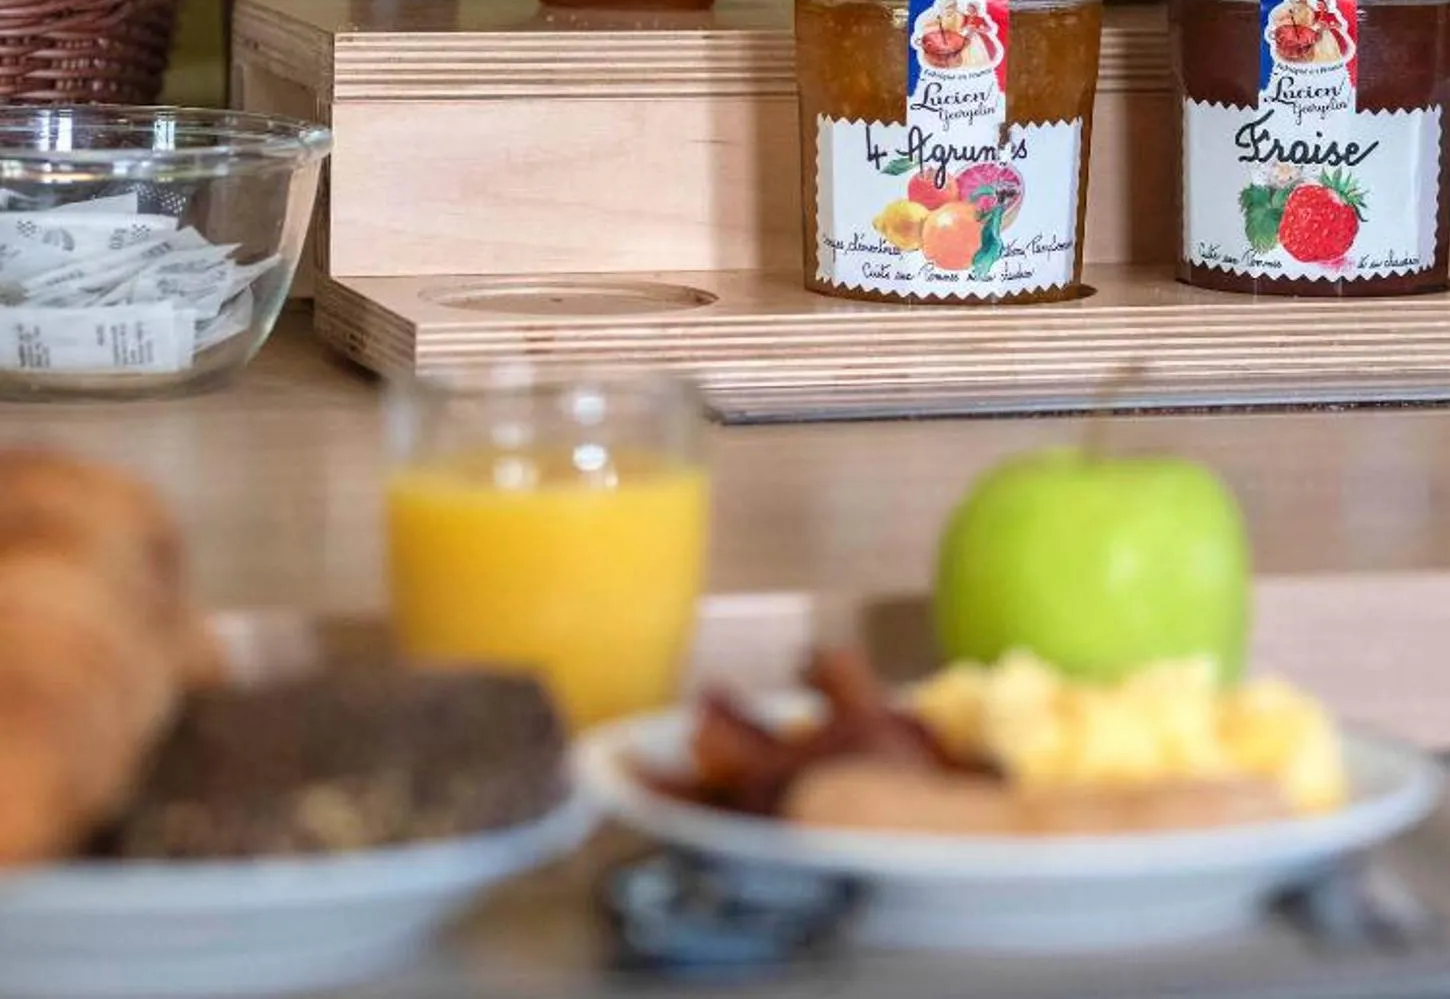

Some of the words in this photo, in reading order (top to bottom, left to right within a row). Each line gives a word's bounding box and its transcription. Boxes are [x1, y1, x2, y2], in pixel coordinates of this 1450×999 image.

[910, 82, 993, 112] Lucien
[1264, 76, 1345, 105] Lucien
[866, 125, 887, 170] 4
[896, 125, 1028, 190] Agrums
[1234, 109, 1380, 166] Fraise
